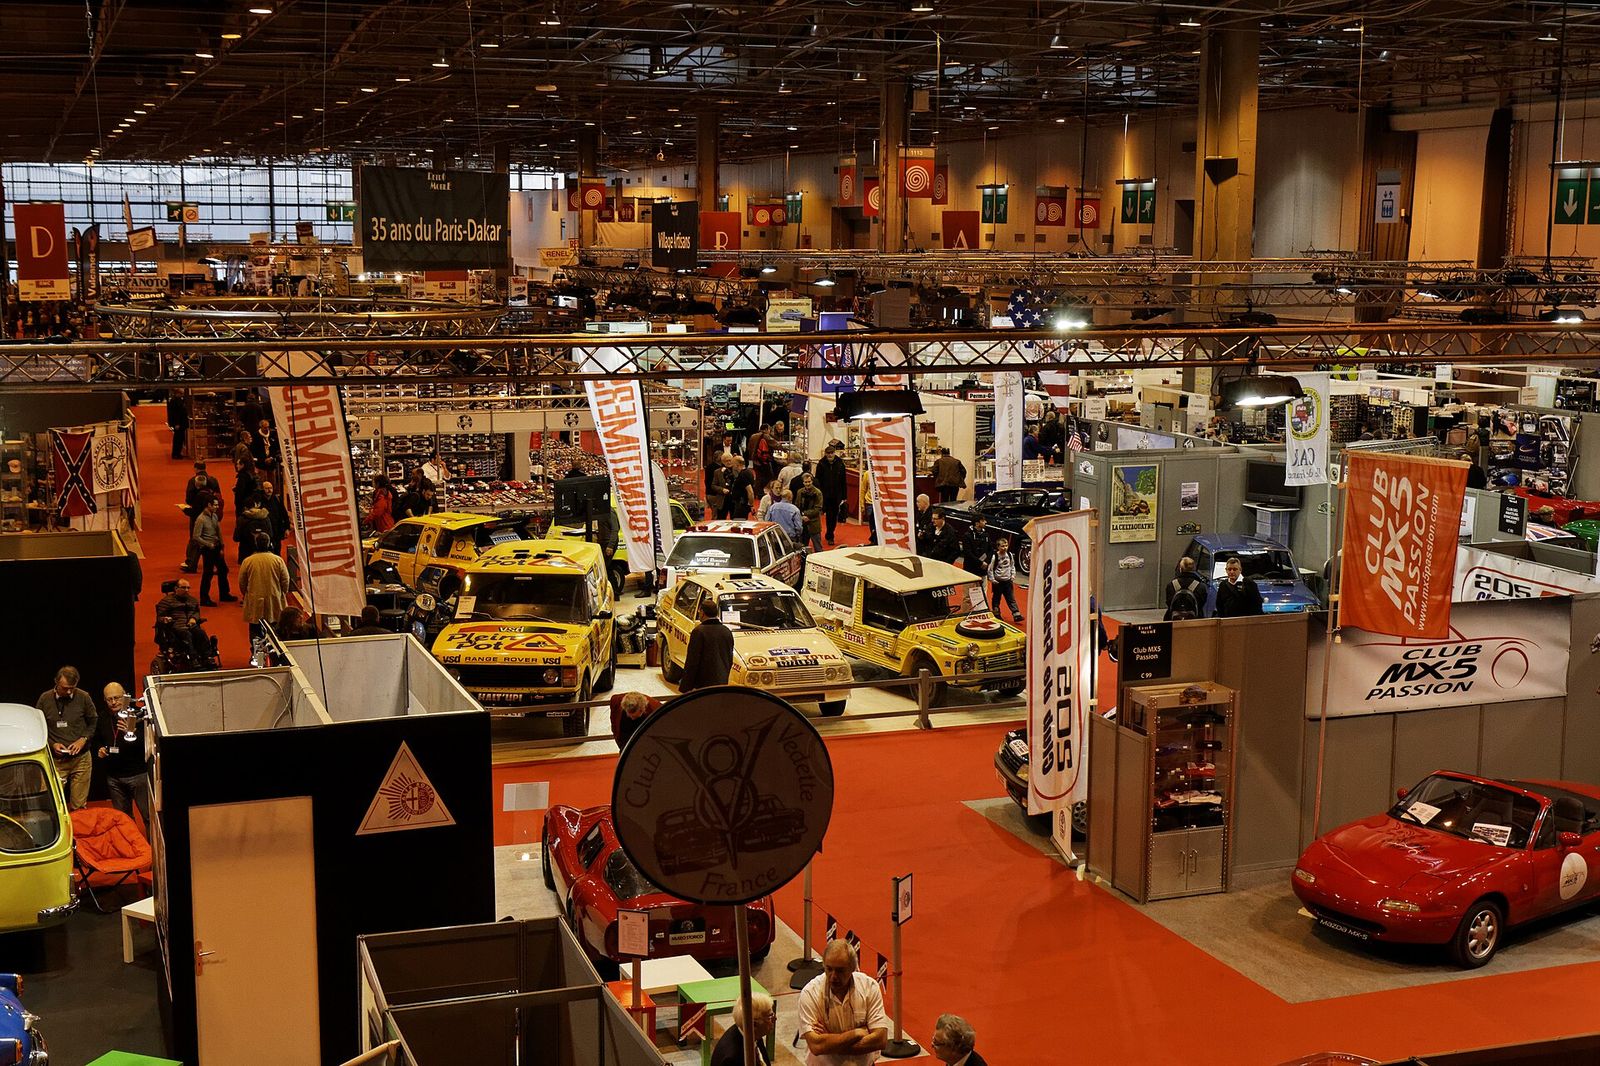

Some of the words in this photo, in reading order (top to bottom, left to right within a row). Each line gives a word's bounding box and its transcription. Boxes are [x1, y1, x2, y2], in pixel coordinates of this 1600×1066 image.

[371, 216, 387, 242] 35
[390, 222, 413, 242] ans
[415, 217, 432, 242] du
[435, 217, 502, 242] Paris-Dakar
[30, 225, 54, 259] D
[658, 231, 674, 254] Village
[88, 252, 97, 297] Vulcanet
[130, 291, 165, 300] ulcanet
[1366, 467, 1389, 576] CLUB
[424, 526, 438, 535] CAMEL
[1381, 475, 1413, 611] MX-5
[450, 553, 473, 561] MICHELIN
[1403, 482, 1432, 627] PASSION
[1418, 493, 1441, 638] www.mx5passion.com
[931, 586, 956, 599] oasis
[819, 599, 834, 612] oasis
[498, 625, 525, 633] vsd
[916, 621, 939, 631] TOTAL
[446, 632, 516, 644] Plein
[843, 632, 866, 645] TOTAL
[455, 641, 504, 651] Pot
[1133, 647, 1147, 658] Club
[1148, 645, 1161, 657] MX5
[1403, 644, 1483, 660] CLUB
[443, 654, 461, 664] vsd
[542, 656, 561, 665] vsd
[1136, 654, 1159, 665] Passion
[1146, 671, 1153, 679] 99
[1376, 657, 1478, 687] MX-5
[1364, 681, 1473, 701] PASSION
[777, 722, 817, 803] Vedette
[625, 753, 662, 808] Club
[700, 866, 778, 896] France
